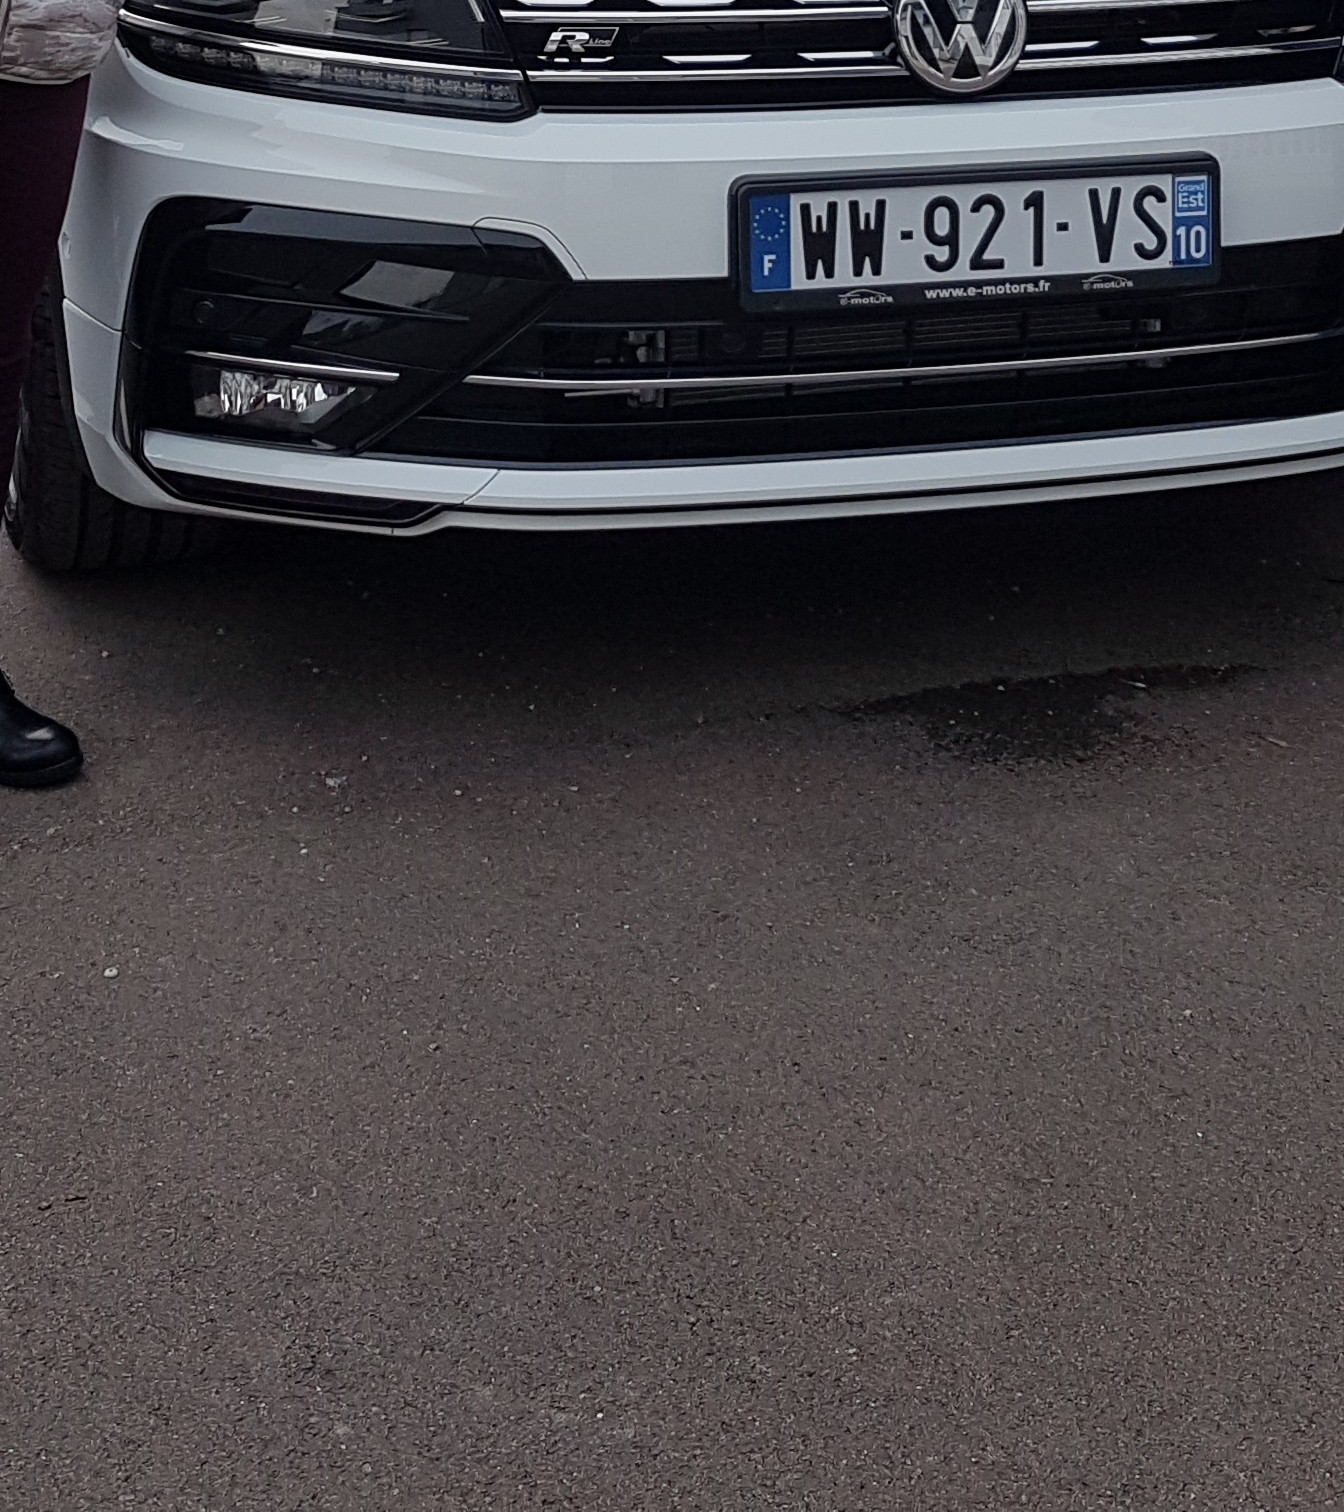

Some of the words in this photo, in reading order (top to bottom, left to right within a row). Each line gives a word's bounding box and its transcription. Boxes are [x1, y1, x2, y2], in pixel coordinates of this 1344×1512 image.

[1178, 182, 1205, 192] Grand
[1177, 191, 1205, 208] Est
[799, 184, 1168, 281] WW-921-VS
[1175, 224, 1207, 260] 10
[763, 254, 777, 276] F
[924, 279, 1051, 300] www.e-motors.fr
